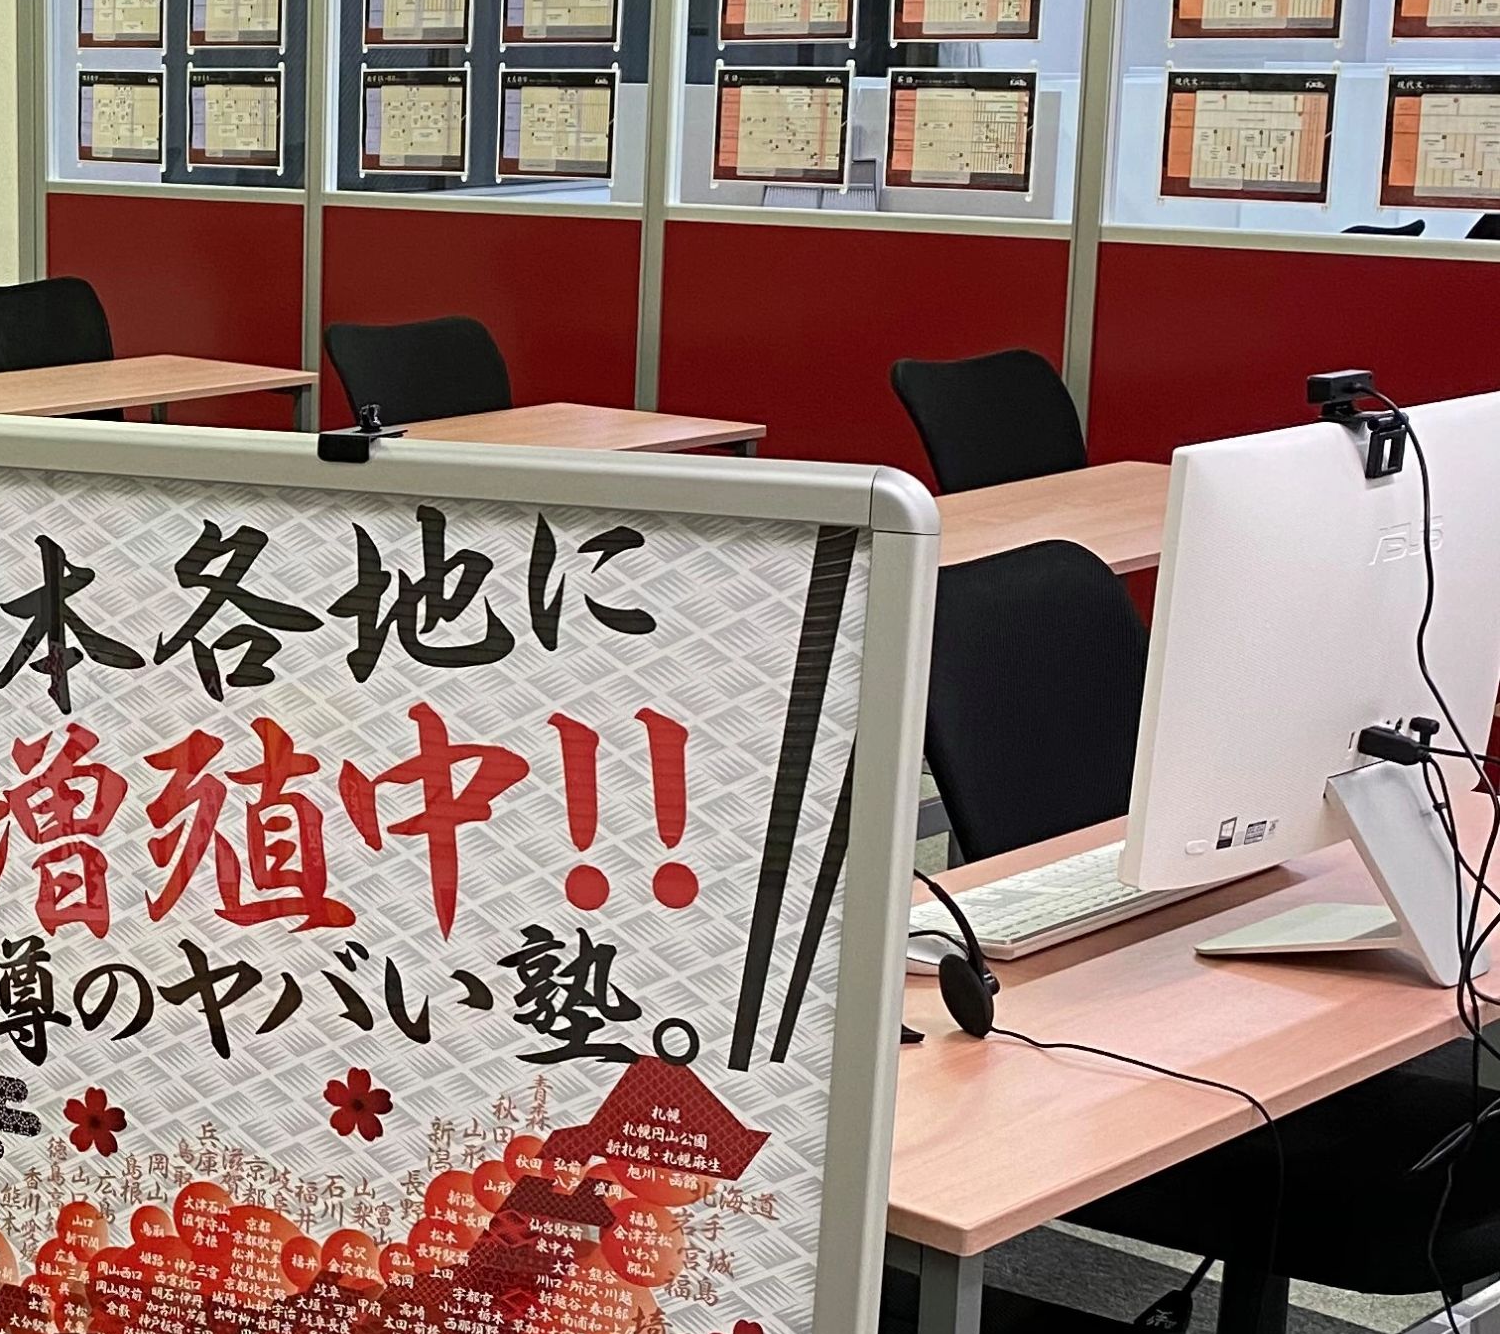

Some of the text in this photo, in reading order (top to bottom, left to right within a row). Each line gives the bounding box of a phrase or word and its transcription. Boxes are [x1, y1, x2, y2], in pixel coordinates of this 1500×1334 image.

[525, 1075, 553, 1131] 青森
[492, 1094, 517, 1144] 秋田
[651, 1106, 680, 1123] 札幌
[427, 1117, 454, 1171] 新潟
[461, 1117, 486, 1169] 山形
[622, 1122, 708, 1149] 札幌円山公園
[197, 1121, 220, 1176] 兵庫
[49, 1137, 67, 1184] 徳島
[516, 1155, 543, 1170] 秋田
[553, 1158, 581, 1175] 弘前
[121, 1153, 142, 1204] 島根
[148, 1154, 169, 1203] 岡山
[243, 1156, 268, 1208] 京都
[484, 1179, 512, 1195] 山形
[552, 1174, 580, 1191] 八戸
[94, 1170, 117, 1224] 広島
[269, 1167, 293, 1216] 岐阜
[321, 1174, 346, 1225] 石川
[400, 1170, 425, 1220] 長野
[448, 1190, 475, 1208] 新潟
[702, 1180, 780, 1221] 北海道
[1, 1185, 22, 1236] 熊本
[184, 1196, 230, 1216] 大津石山
[295, 1178, 318, 1232] 福井
[352, 1177, 375, 1229] 山梨
[72, 1215, 93, 1227] 山口
[245, 1217, 271, 1232] 京都
[373, 1203, 394, 1247] 富山
[530, 1219, 584, 1240] 仙台駅前
[629, 1214, 658, 1229] 福島
[671, 1209, 725, 1241] 岩手
[232, 1231, 282, 1252] 京都駅前
[430, 1230, 457, 1244] 松本
[341, 1243, 367, 1259] 金沢
[389, 1251, 414, 1267] 富山
[416, 1243, 469, 1266] 長野駅前
[623, 1247, 659, 1261] いわき
[679, 1245, 736, 1277] 宮城
[98, 1262, 143, 1280] 岡山西口
[292, 1253, 318, 1270] 福井
[154, 1271, 201, 1290] 西宮北口
[430, 1265, 454, 1279] 上田
[28, 1283, 50, 1296] 松江
[96, 1281, 142, 1301] 岡山駅前
[223, 1277, 286, 1301] 京都北大路
[314, 1283, 340, 1299] 岐阜
[453, 1287, 493, 1306] 宇都宮
[665, 1272, 719, 1306] 福島
[64, 1303, 87, 1317] 高松
[106, 1301, 130, 1318] 倉敷
[357, 1299, 382, 1317] 甲府
[400, 1303, 425, 1319] 高崎
